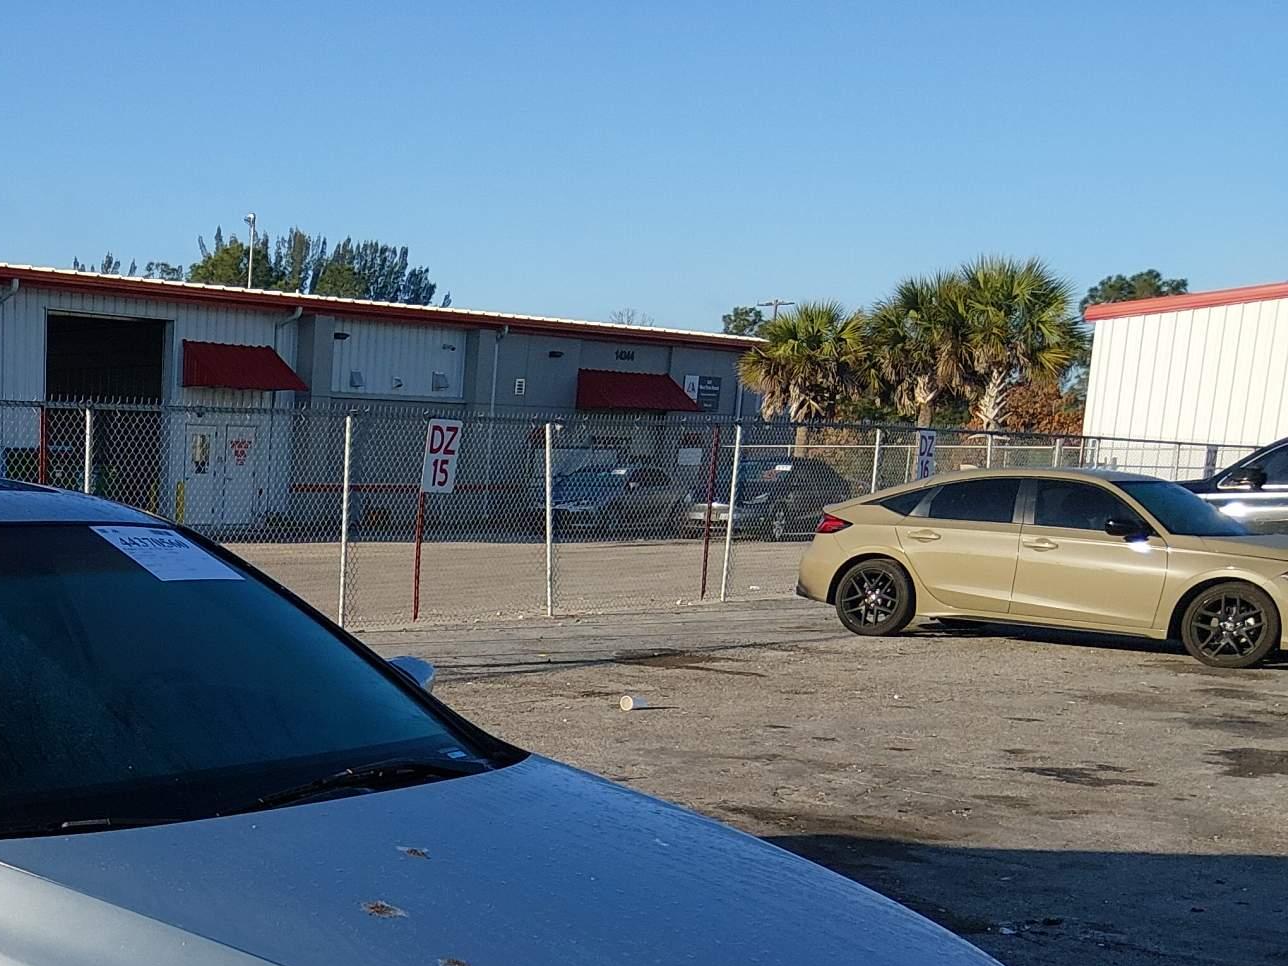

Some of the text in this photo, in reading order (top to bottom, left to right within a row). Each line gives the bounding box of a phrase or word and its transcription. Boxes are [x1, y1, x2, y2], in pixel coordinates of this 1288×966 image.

[430, 425, 459, 455] DZ
[920, 435, 934, 457] DZ
[432, 459, 449, 487] 15
[920, 460, 929, 479] 16
